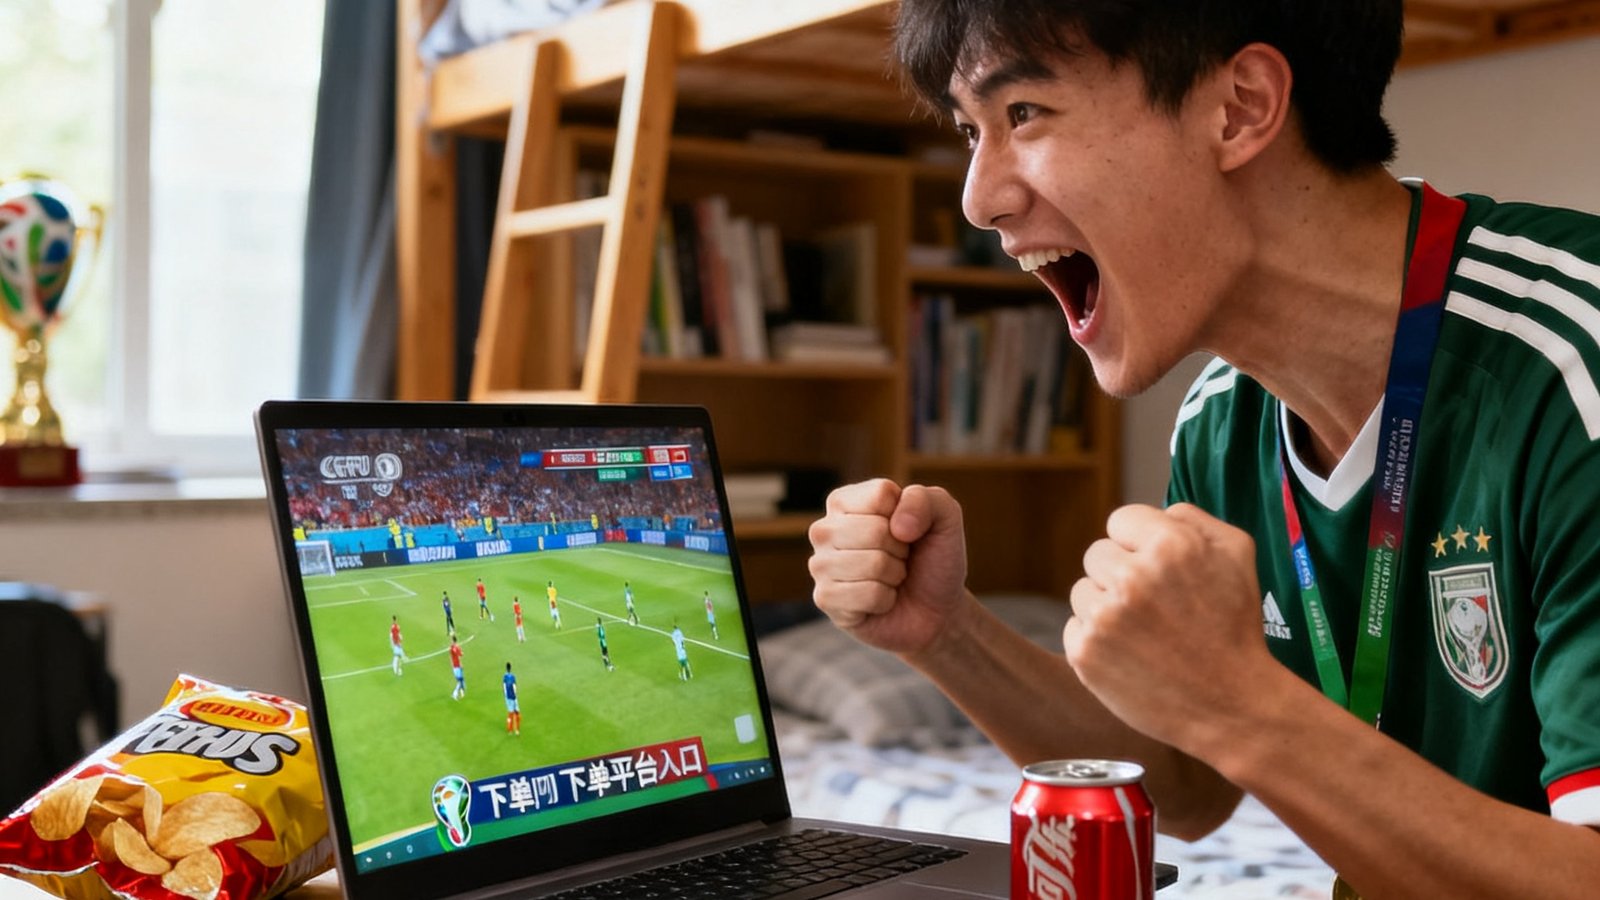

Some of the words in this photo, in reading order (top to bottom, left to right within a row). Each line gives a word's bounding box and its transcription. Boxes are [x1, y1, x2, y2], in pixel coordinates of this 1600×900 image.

[559, 744, 702, 803] 下单平台入口
